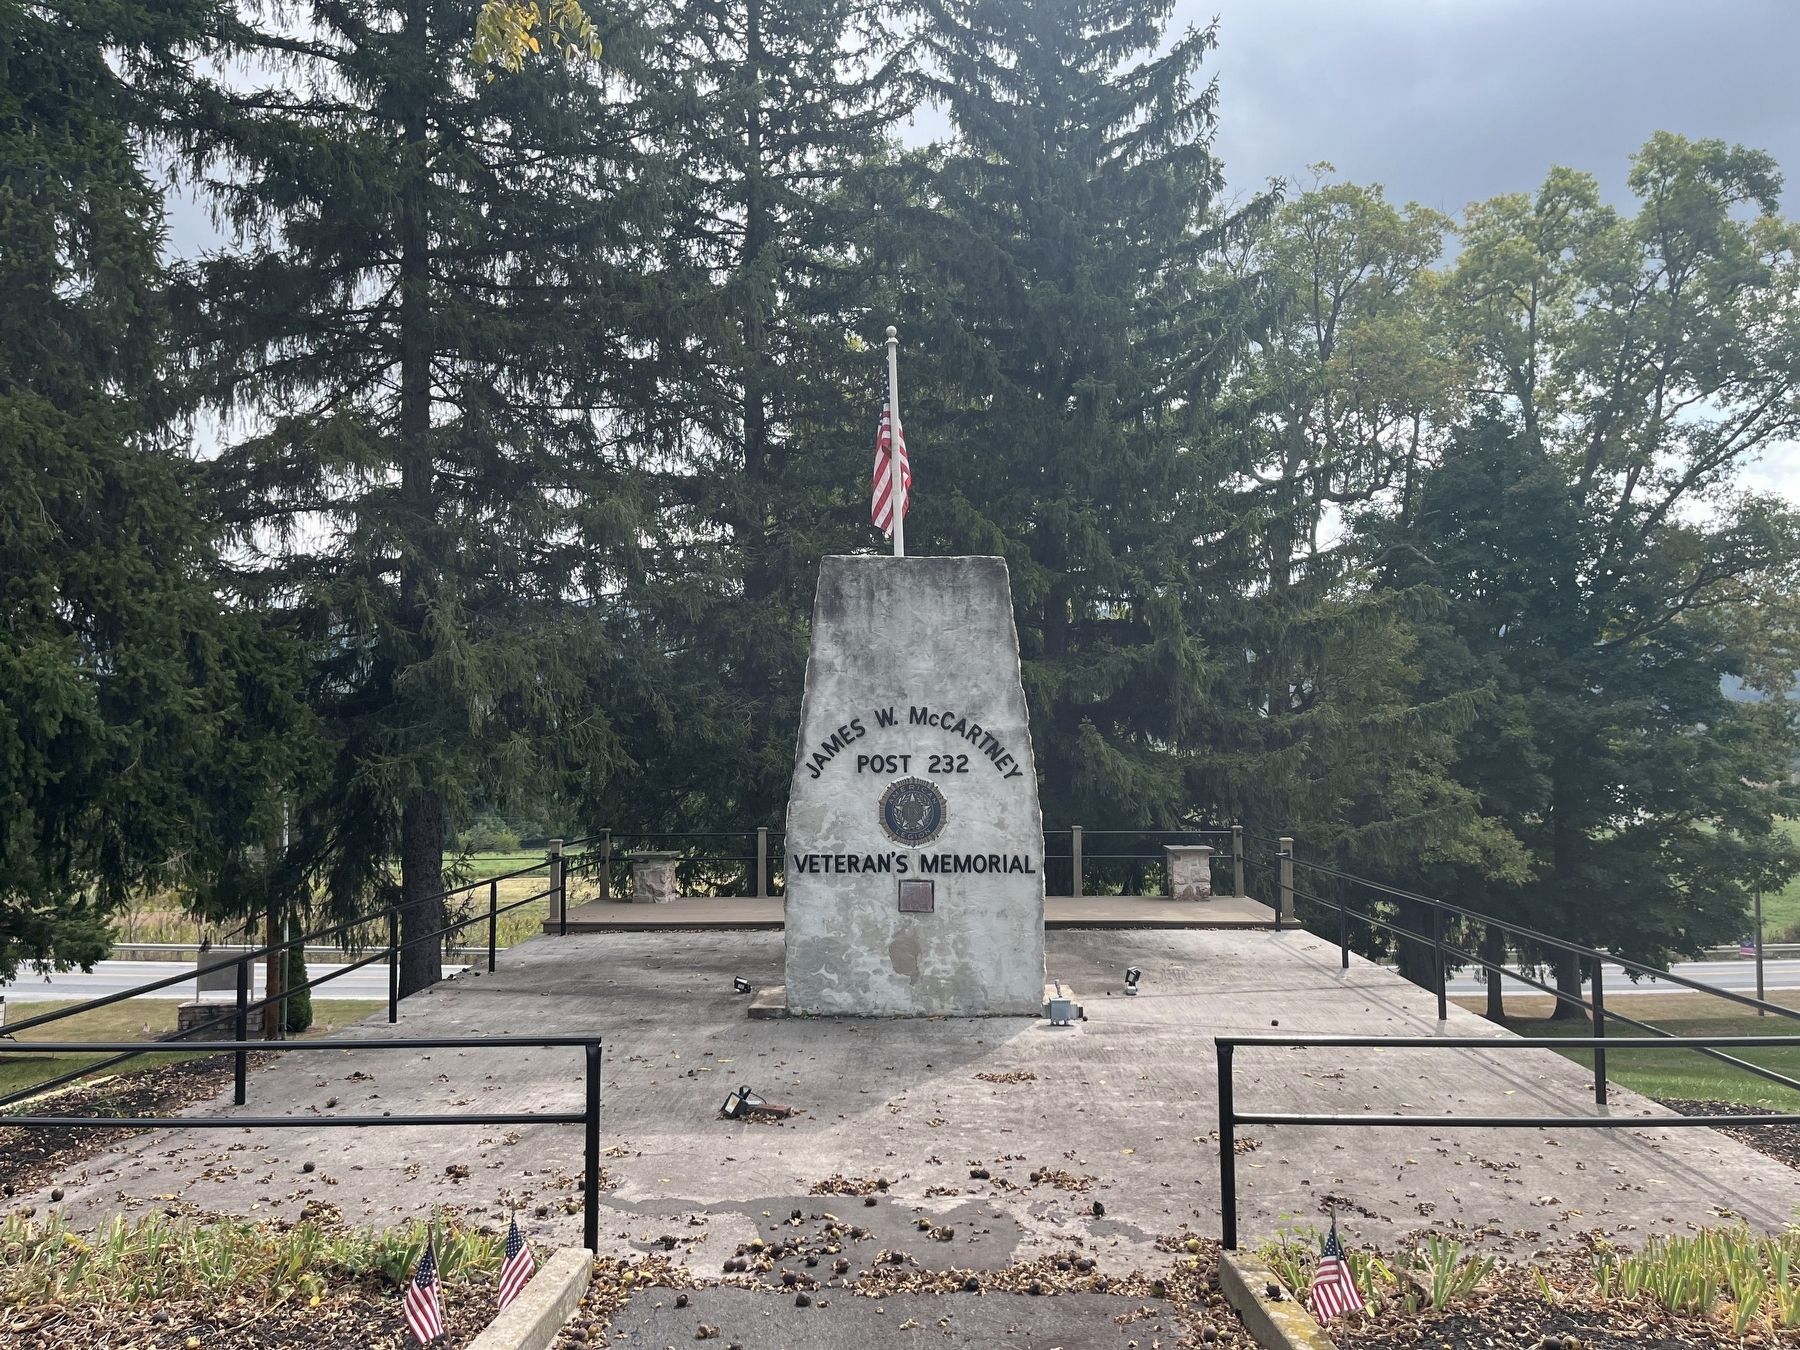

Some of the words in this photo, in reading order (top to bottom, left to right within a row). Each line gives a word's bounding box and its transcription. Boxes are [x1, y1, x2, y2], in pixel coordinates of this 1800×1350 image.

[805, 718, 866, 779] JAMES
[874, 707, 898, 728] W.
[909, 706, 1024, 780] McCARTNEY
[857, 754, 911, 774] POST
[928, 754, 969, 774] 232
[889, 784, 938, 804] AMERICAN
[895, 829, 931, 840] LEGION
[793, 851, 908, 874] VETERAN'S
[920, 853, 1036, 874] MEMORIAL
